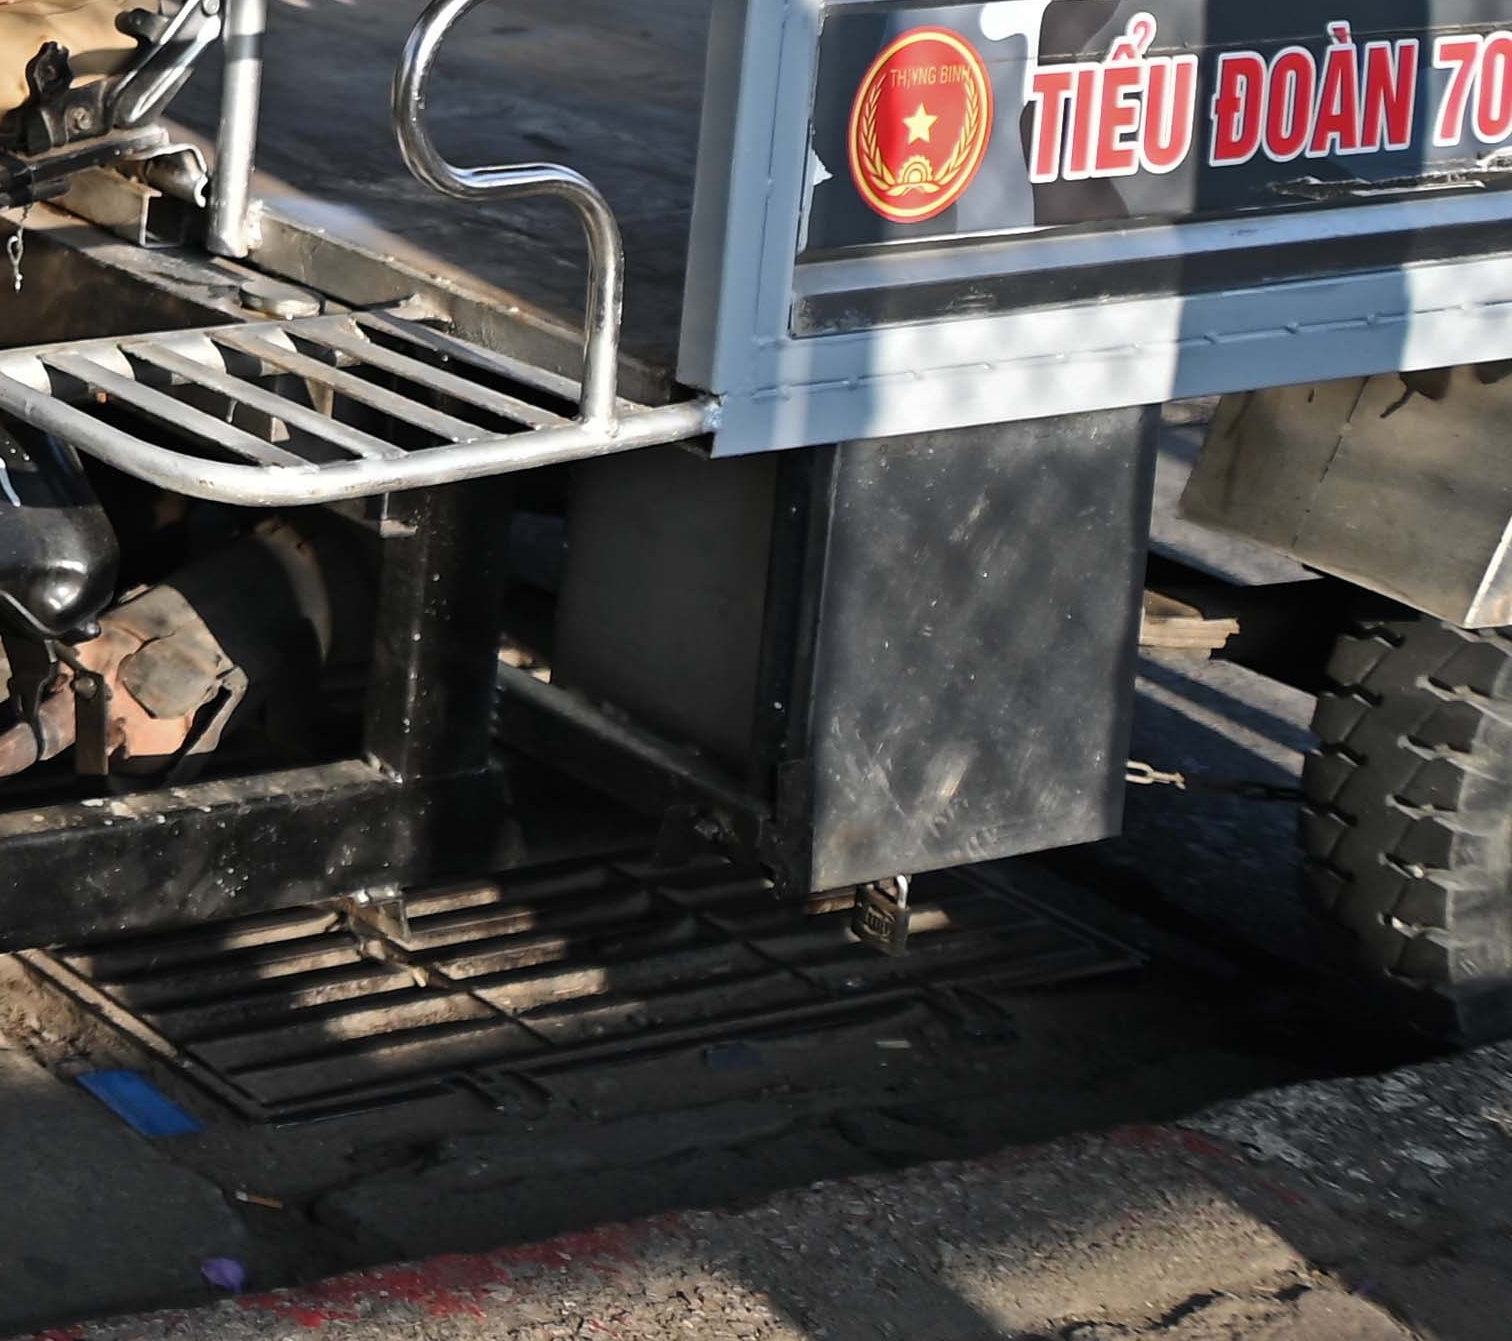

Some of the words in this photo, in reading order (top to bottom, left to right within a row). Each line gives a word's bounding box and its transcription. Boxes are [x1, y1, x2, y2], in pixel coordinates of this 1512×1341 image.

[1031, 14, 1196, 182] TIỂU
[1211, 22, 1418, 165] ĐOÀN
[1434, 31, 1512, 147] 70
